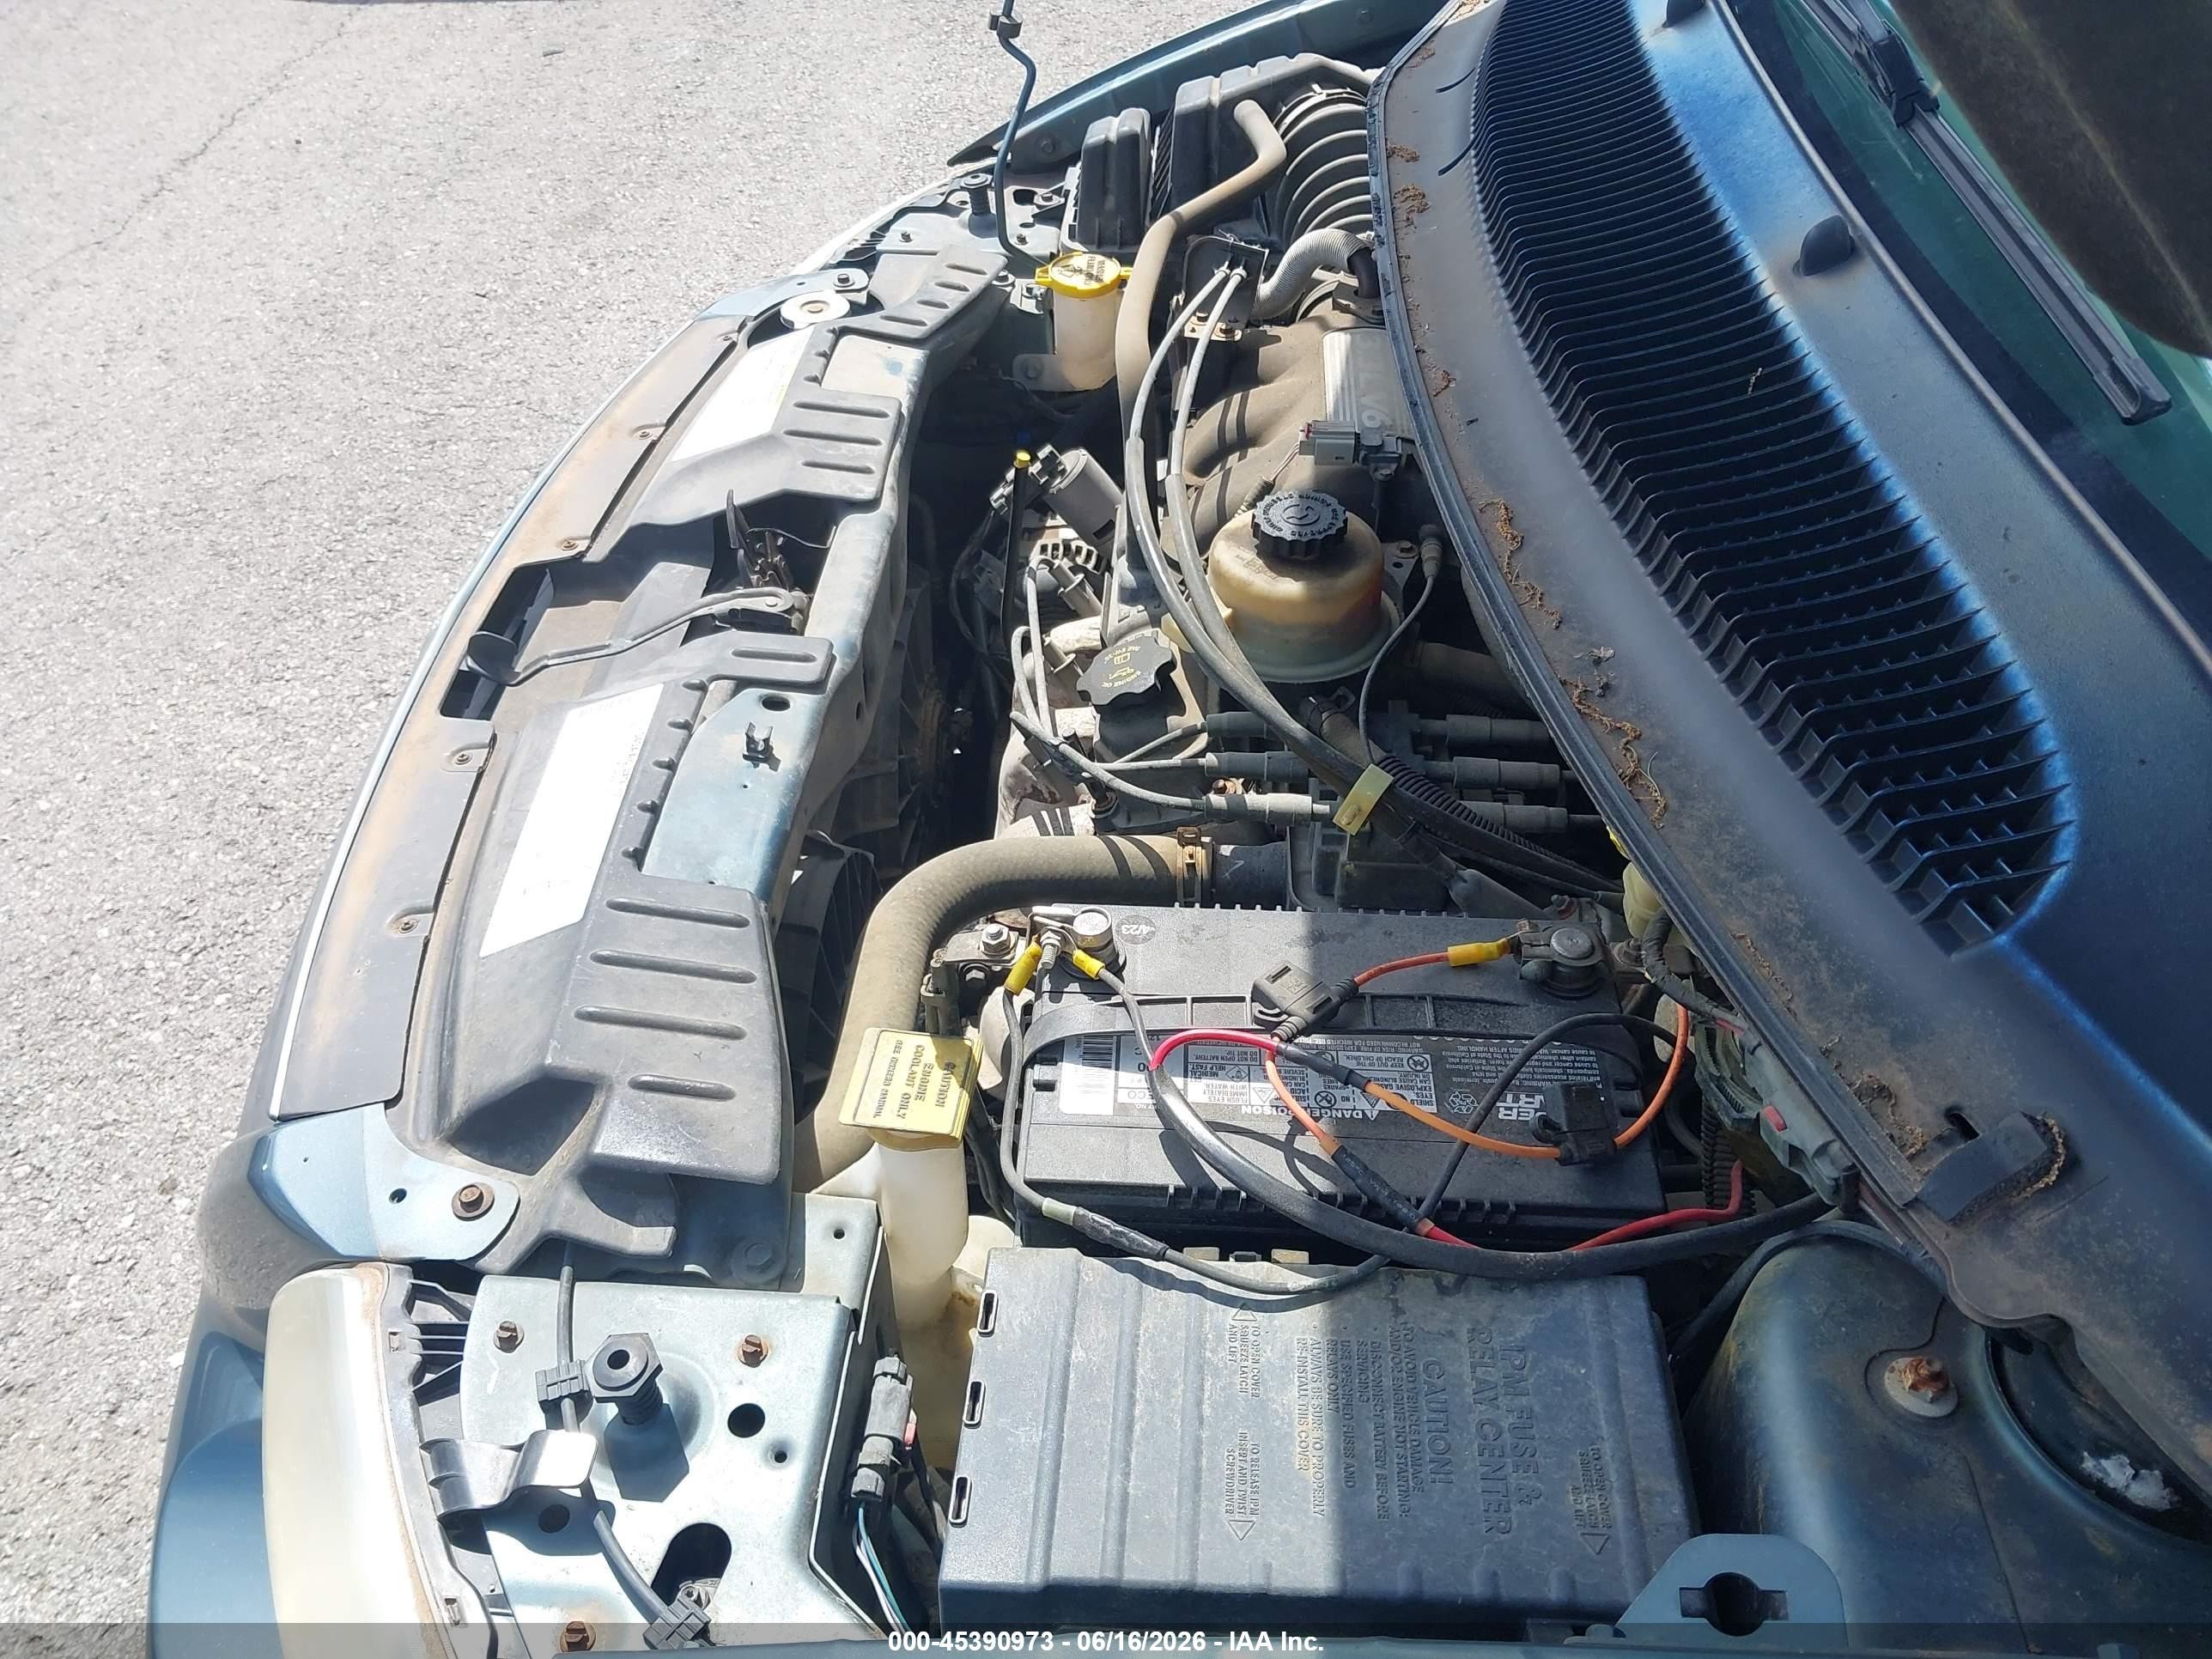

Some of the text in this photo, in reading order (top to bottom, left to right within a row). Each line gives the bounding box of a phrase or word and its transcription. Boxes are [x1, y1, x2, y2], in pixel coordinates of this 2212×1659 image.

[1361, 392, 1394, 428] V6
[1121, 925, 1149, 935] 4/23
[896, 1044, 925, 1119] COOLANT ONLY
[915, 1062, 933, 1102] ENGINE
[935, 1061, 956, 1108] CAUTION
[1228, 1323, 1238, 1364] AND LIFT
[1239, 1324, 1249, 1394] SQUEEZE LATCH
[1250, 1325, 1261, 1398] TO OPEN COVER
[1326, 1340, 1340, 1414] RELAYS ONLY
[1355, 1340, 1370, 1404] SERVICING
[1296, 1338, 1310, 1472] RE-INSTALL THIS COVER
[1310, 1338, 1326, 1517] ALWAYS BE SURE TO PROPERLY
[1339, 1340, 1356, 1489] USE SPECIFIED FUSES AND
[1369, 1340, 1390, 1520] DISCONNECT BATTERY BEFORE
[1389, 1326, 1411, 1518] AND/OR ENGINE NOT STARTING:
[1402, 1326, 1424, 1493] TO AVOID VEHICLE DAMAGE
[1422, 1358, 1454, 1485] CAUTION!
[1467, 1328, 1512, 1535] RELAY CENTER
[1498, 1346, 1542, 1505] IPM FUSE &
[1224, 1448, 1236, 1515] SCREWDRIVER
[1237, 1431, 1249, 1516] INSERT AND TWIST
[1249, 1443, 1261, 1516] TO RELEASE IPM
[1571, 1485, 1586, 1528] AND LIFT
[1578, 1451, 1600, 1528] SQUEEZE LATCH
[1590, 1445, 1612, 1528] TO OPEN COVER
